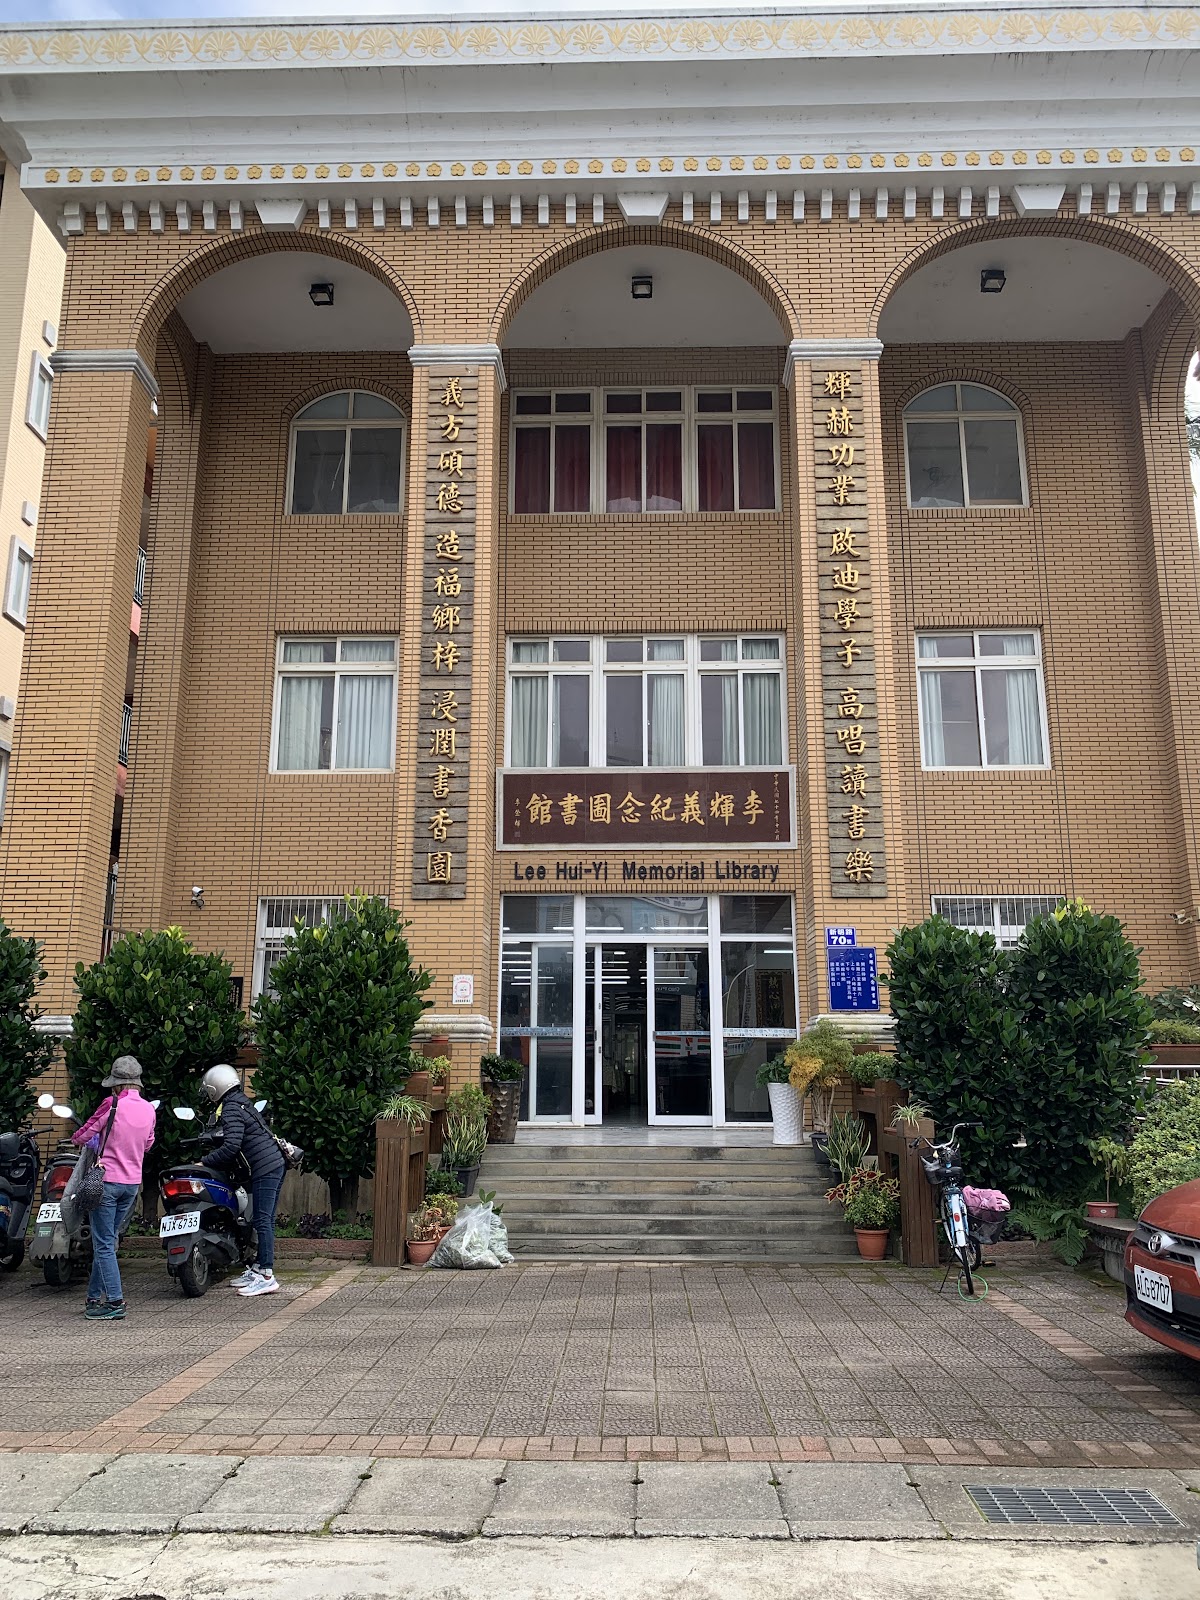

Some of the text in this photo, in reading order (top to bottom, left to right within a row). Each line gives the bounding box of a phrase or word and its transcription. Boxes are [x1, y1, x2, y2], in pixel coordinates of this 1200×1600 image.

[525, 789, 765, 827] 李輝義紀念圖書館
[514, 860, 780, 882] Lee Hui-Yi Memorial Library
[161, 1216, 198, 1232] NJX-6733
